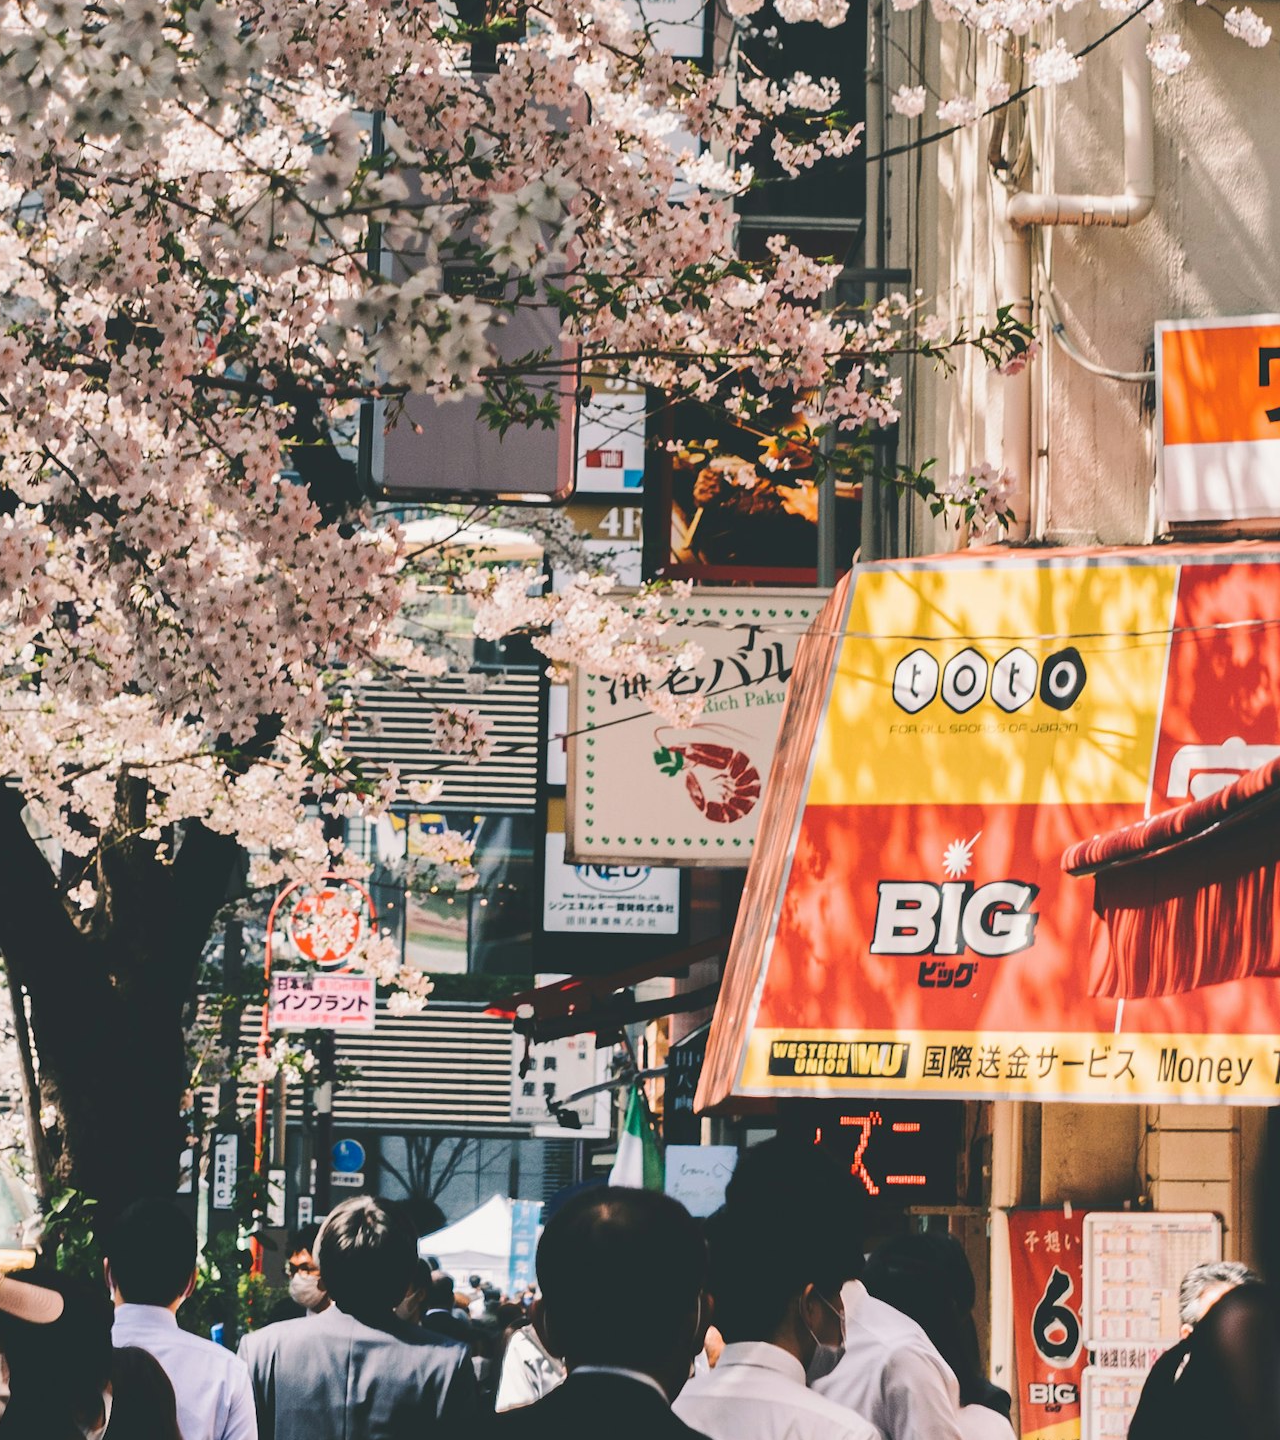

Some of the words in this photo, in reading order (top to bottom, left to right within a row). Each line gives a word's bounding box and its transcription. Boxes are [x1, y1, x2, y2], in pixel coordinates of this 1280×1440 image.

[898, 652, 1084, 708] toto
[870, 881, 1040, 958] BIG
[918, 961, 979, 988] ビッグ
[773, 1043, 851, 1059] WESTERN
[794, 1058, 848, 1075] UNION
[921, 1044, 1136, 1080] 国際送金サービス
[1157, 1048, 1254, 1087] Money
[1031, 1265, 1084, 1369] 6
[1028, 1381, 1081, 1406] BIG
